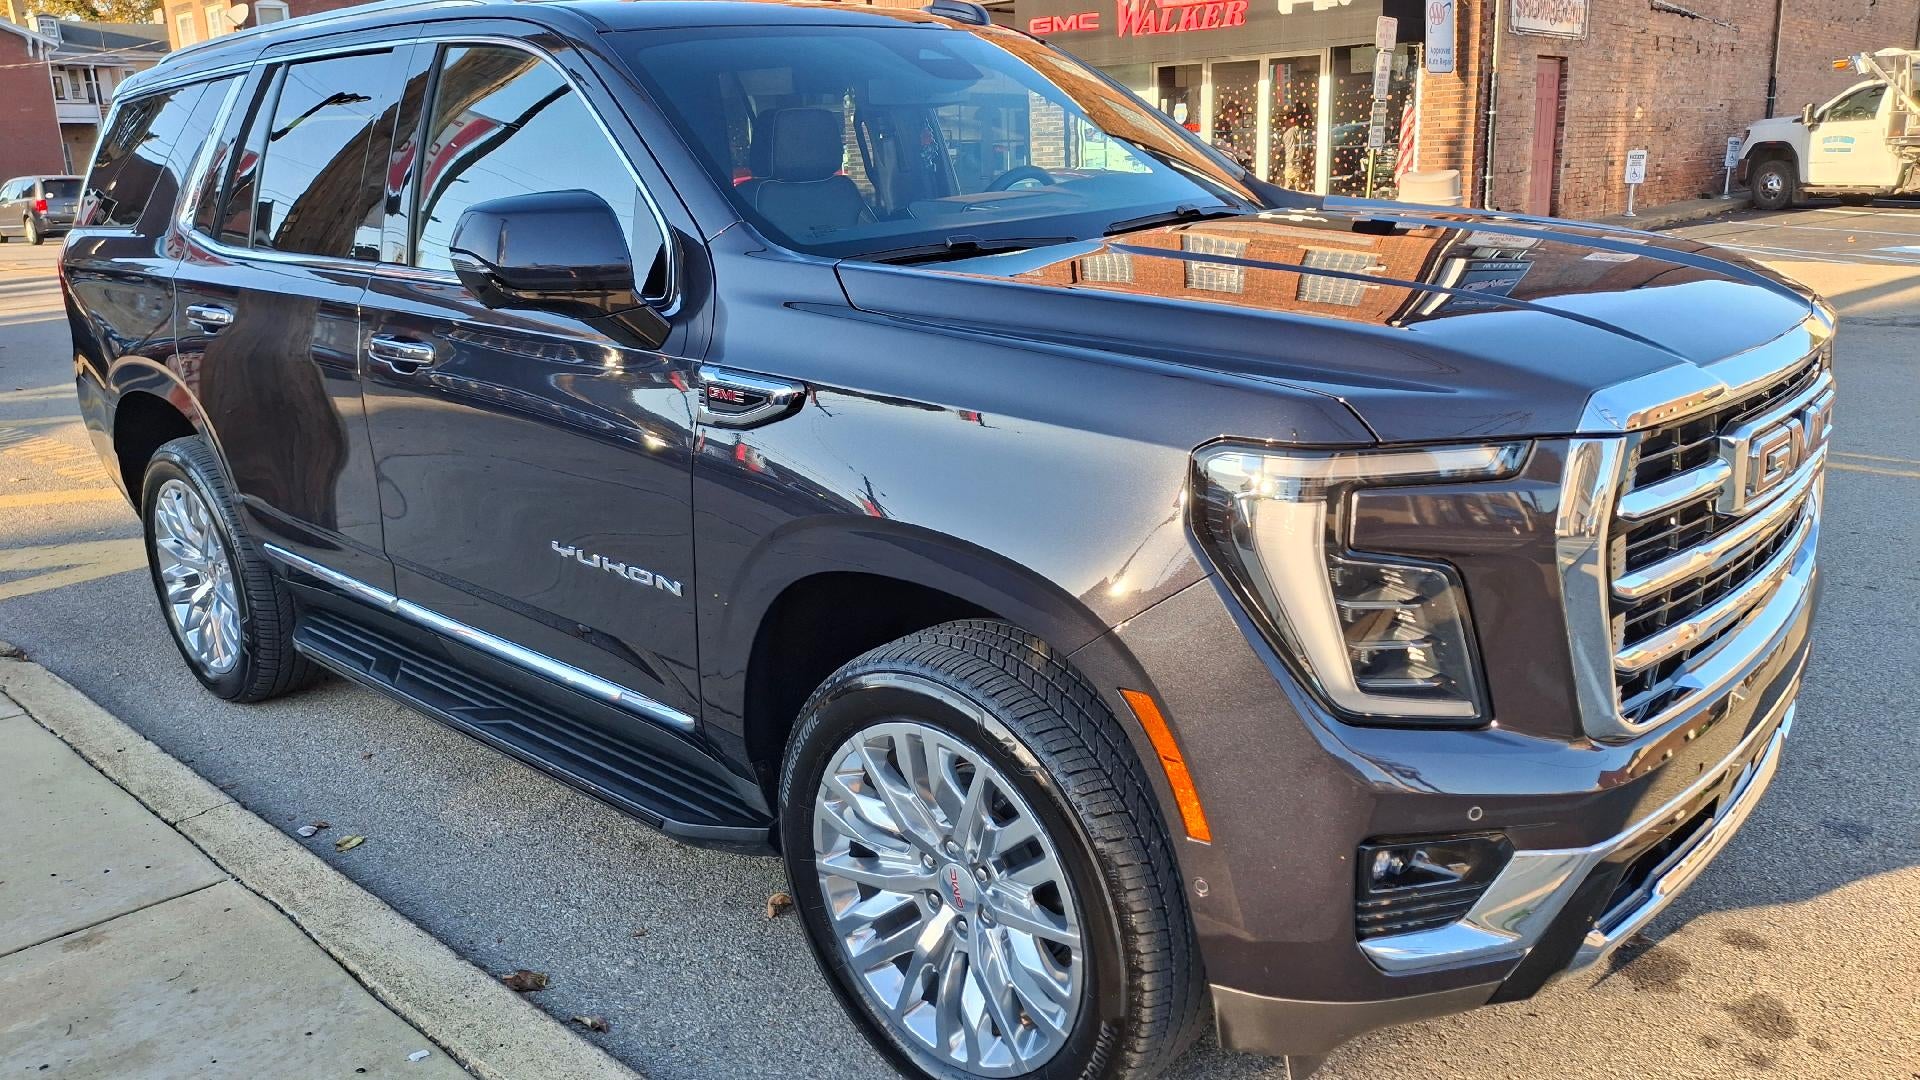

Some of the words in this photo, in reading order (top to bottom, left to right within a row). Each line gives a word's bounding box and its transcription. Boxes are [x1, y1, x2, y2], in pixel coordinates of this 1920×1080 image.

[1029, 13, 1100, 34] GMC
[1116, 0, 1248, 37] WALKER
[708, 386, 745, 404] GMC
[551, 540, 683, 597] YUKON
[781, 708, 820, 808] BRIDGESTONE
[949, 867, 965, 909] GMC
